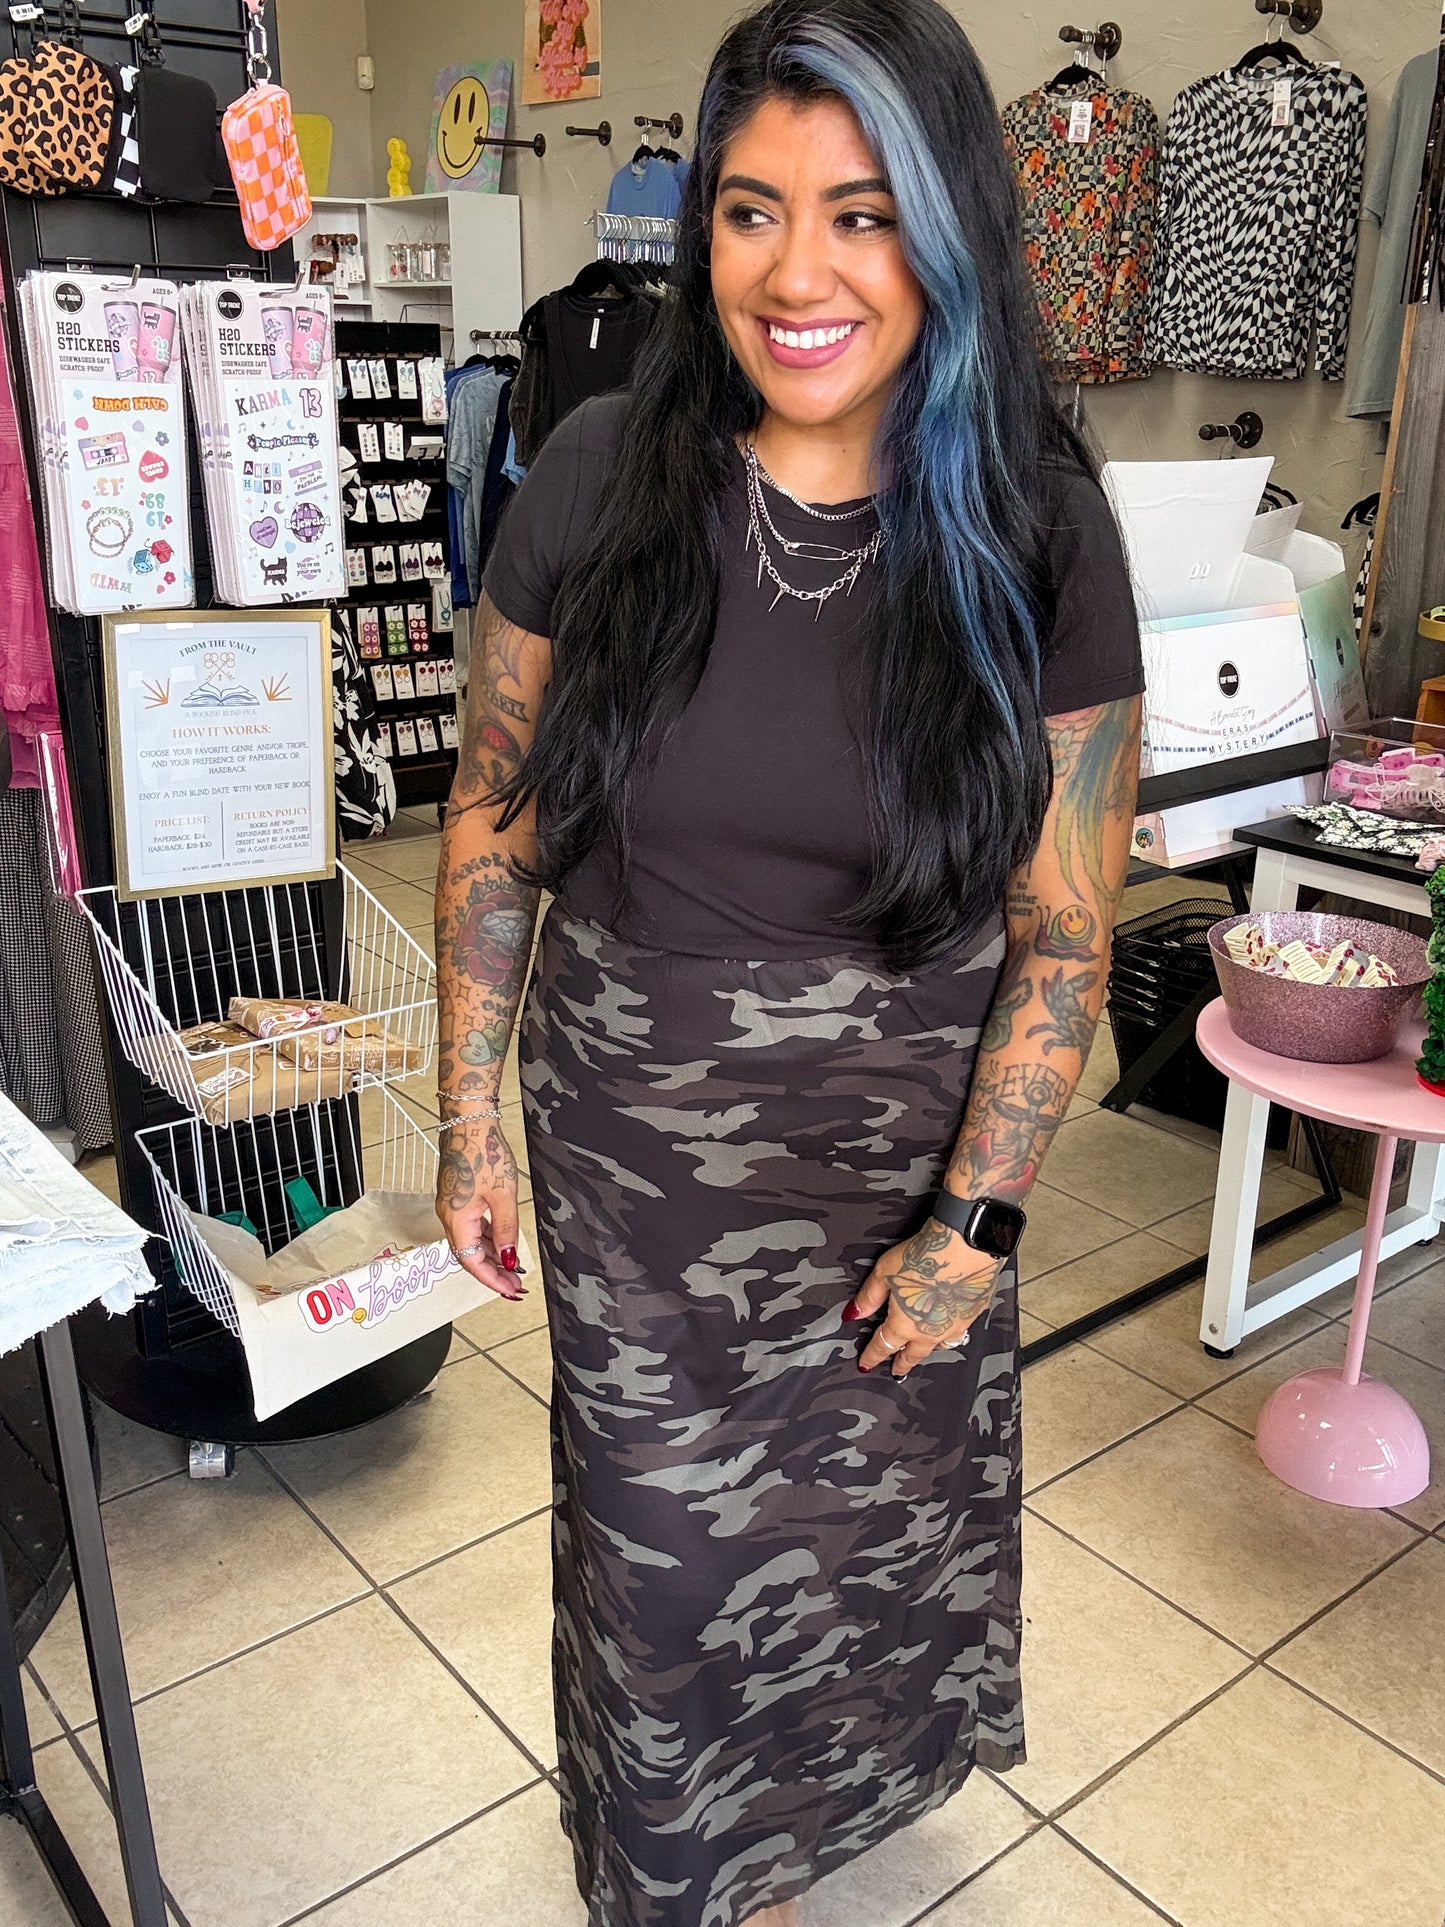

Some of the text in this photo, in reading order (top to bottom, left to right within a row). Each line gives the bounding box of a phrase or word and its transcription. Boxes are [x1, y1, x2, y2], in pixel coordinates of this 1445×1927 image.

[57, 337, 120, 353] STICKERS
[220, 343, 276, 356] STICKERS
[59, 356, 96, 364] DISHWASHER
[92, 396, 169, 412] CALM DOWN
[235, 387, 292, 416] KARMA
[299, 388, 323, 418] 13
[96, 477, 121, 496] 13
[145, 493, 165, 509] 89
[146, 510, 165, 527] 19
[284, 515, 331, 530] Bejeweled
[90, 572, 132, 594] WWTD
[179, 640, 258, 658] FROM THE VAULT
[172, 724, 272, 739] HOW IT WORKS:
[1222, 724, 1248, 737] ERAS
[140, 749, 170, 758] CHOOSE
[172, 748, 193, 756] YOUR
[195, 746, 230, 754] FAVORITE
[231, 744, 254, 753] GENRE
[256, 742, 284, 751] AND/OR
[1208, 734, 1265, 755] MYSTERY
[151, 760, 168, 768] AND
[170, 759, 190, 767] YOUR
[192, 756, 235, 765] PREFERENCE
[238, 755, 246, 763] OF
[249, 753, 288, 762] PAPERBACK
[209, 765, 247, 775] HARDBACK
[139, 792, 160, 800] ENJOY
[172, 790, 187, 798] FUN
[190, 788, 210, 796] BLIND
[212, 786, 230, 795] DATE
[232, 784, 252, 793] WITH
[254, 783, 272, 791] YOUR
[274, 781, 289, 790] NEW
[154, 816, 211, 828] PRICE LIST:
[234, 807, 311, 821] RETURN POLICY:
[237, 829, 271, 837] REFUNDABLE
[306, 1278, 356, 1325] ON
